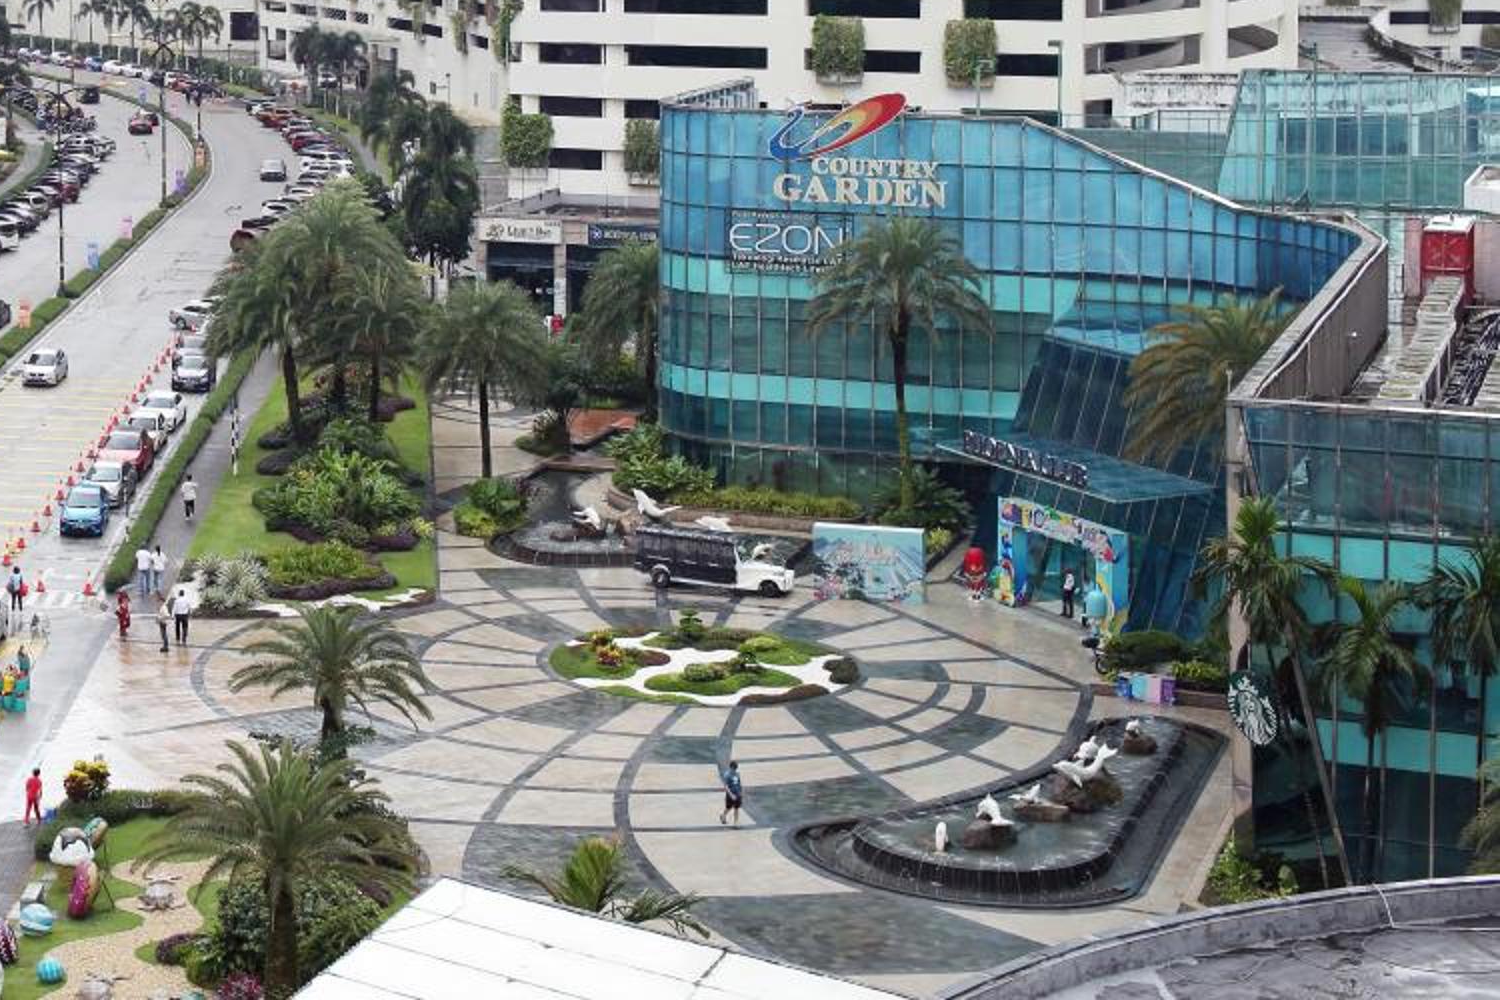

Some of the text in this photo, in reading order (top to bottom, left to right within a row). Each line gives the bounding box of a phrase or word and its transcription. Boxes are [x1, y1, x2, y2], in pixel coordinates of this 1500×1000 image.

[811, 157, 938, 179] COUNTRY
[773, 173, 948, 208] GARDEN
[729, 223, 844, 255] EZON
